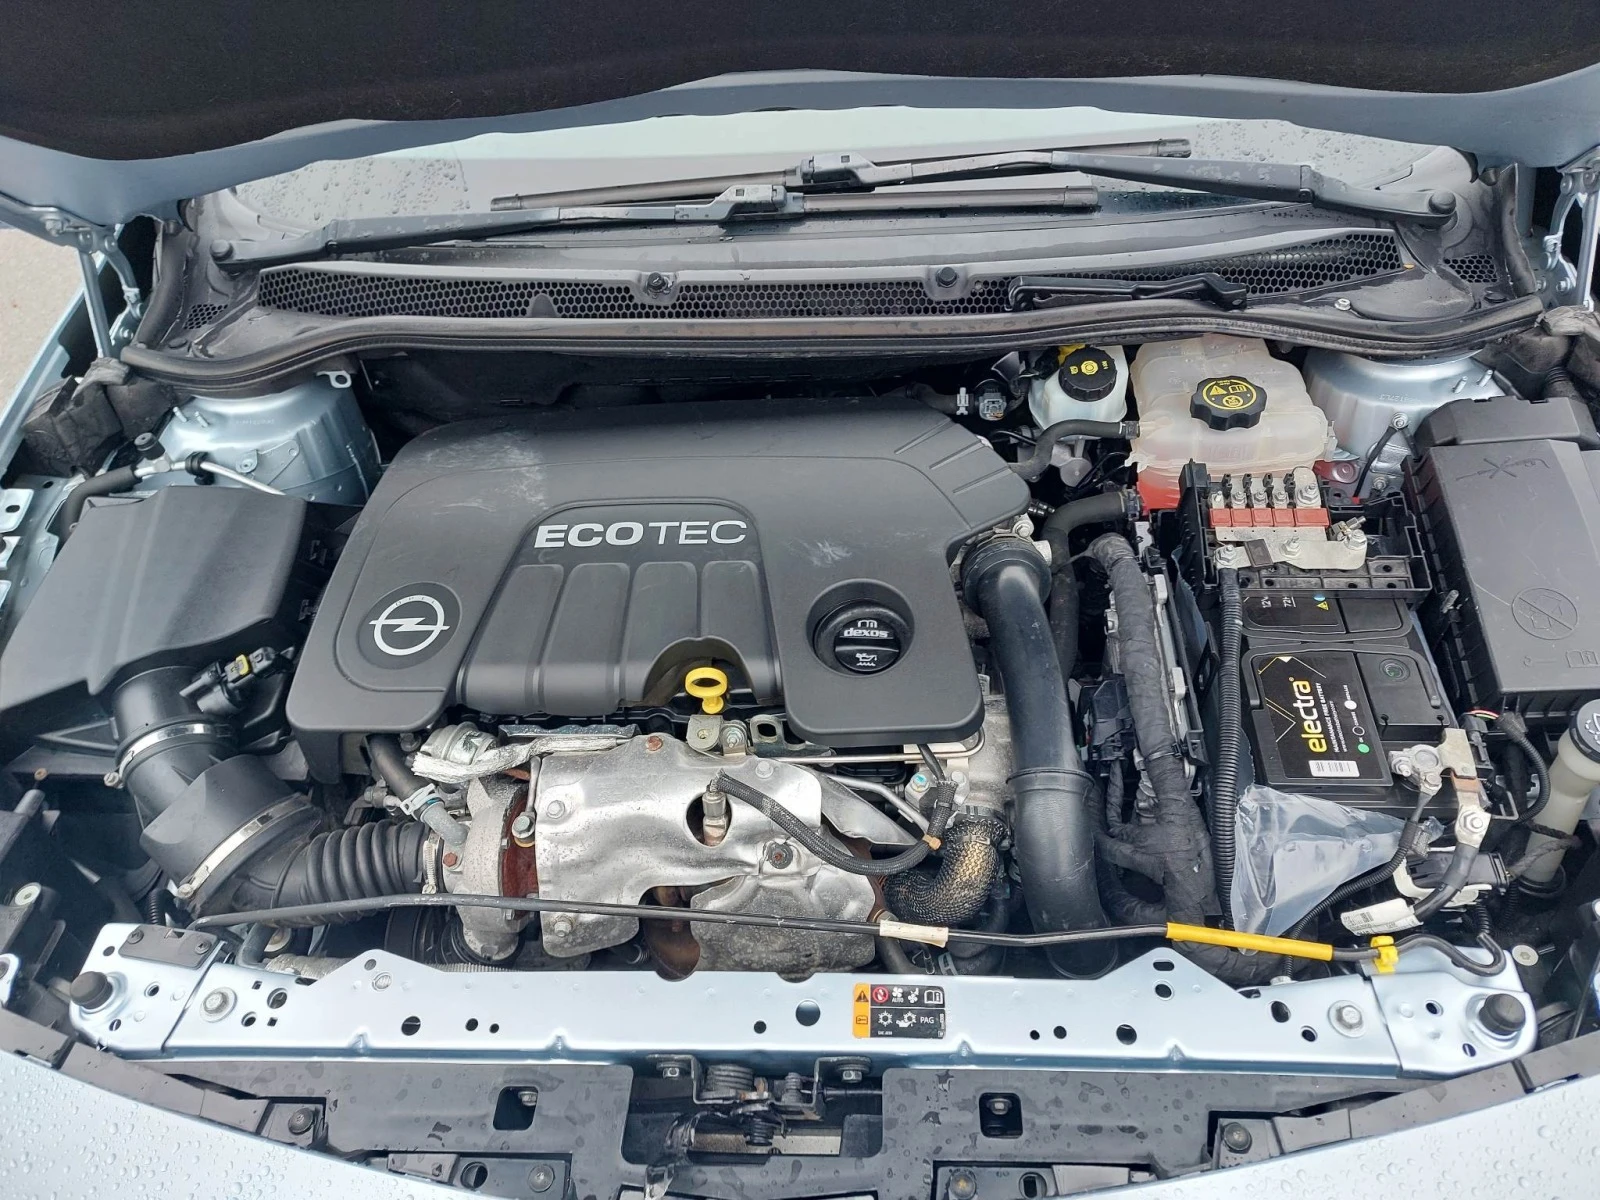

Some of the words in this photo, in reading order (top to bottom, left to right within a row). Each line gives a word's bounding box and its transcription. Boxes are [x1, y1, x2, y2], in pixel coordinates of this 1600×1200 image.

[534, 520, 747, 548] ECOTEC
[843, 627, 890, 638] dexos
[1292, 680, 1328, 753] electra
[920, 1016, 935, 1024] PAG
